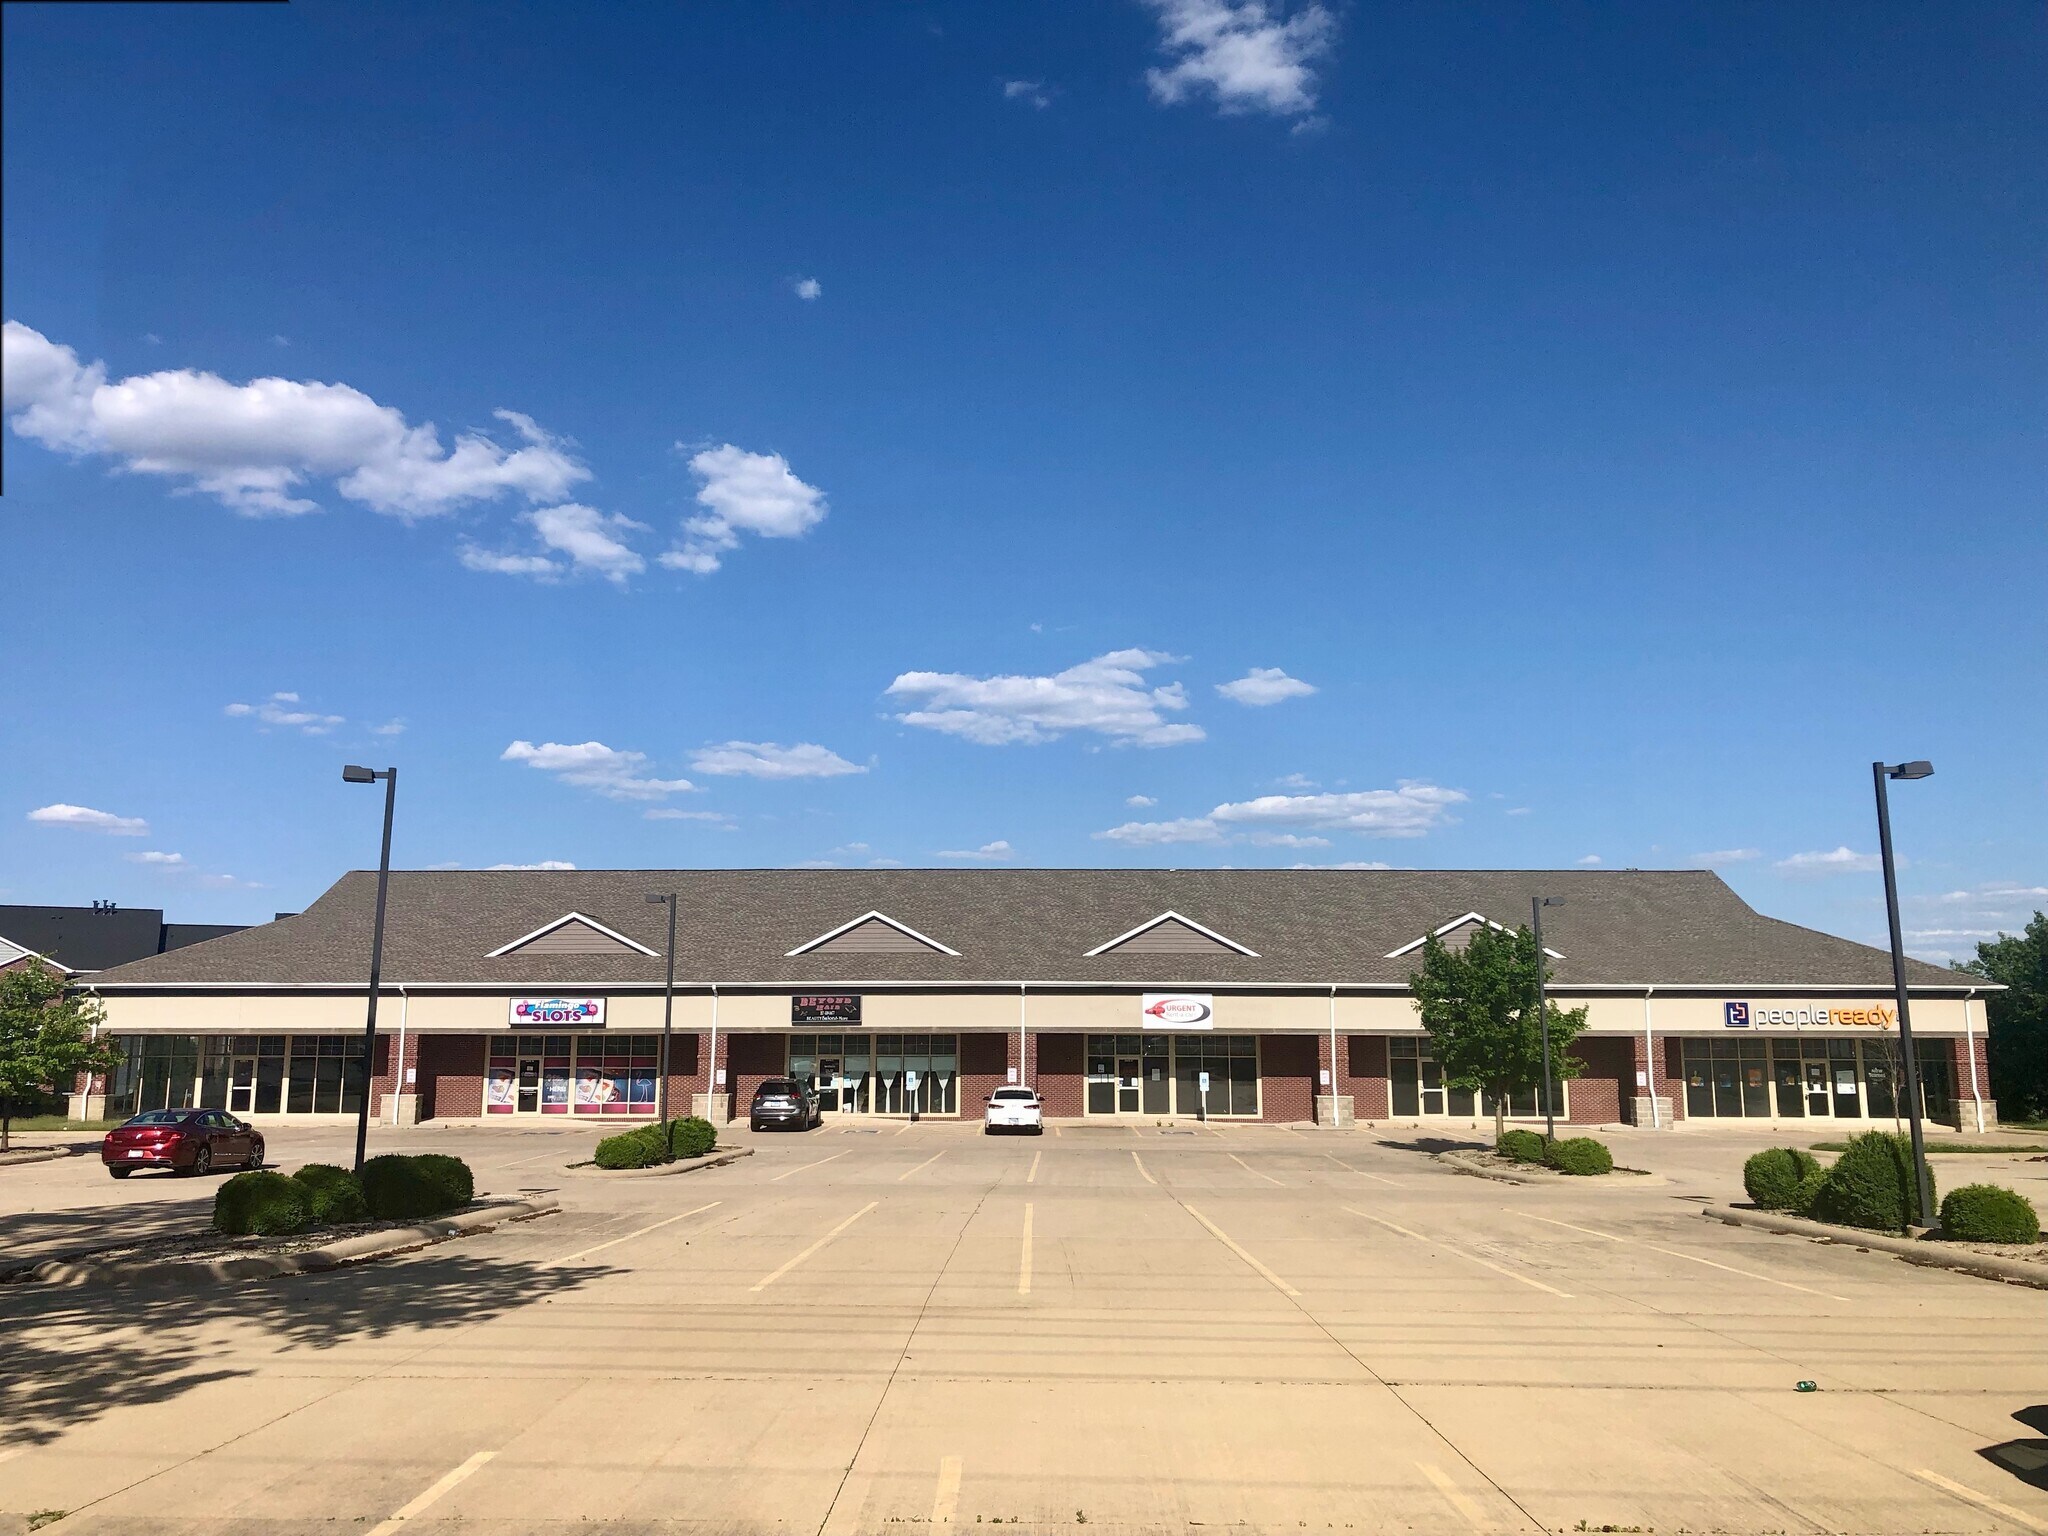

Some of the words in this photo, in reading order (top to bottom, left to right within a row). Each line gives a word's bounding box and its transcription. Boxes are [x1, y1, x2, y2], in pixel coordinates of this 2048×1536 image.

[534, 1000, 580, 1010] Flamingo
[800, 997, 852, 1006] BEYOND
[532, 1010, 581, 1021] SLOTS
[1755, 1004, 1896, 1030] peopleready
